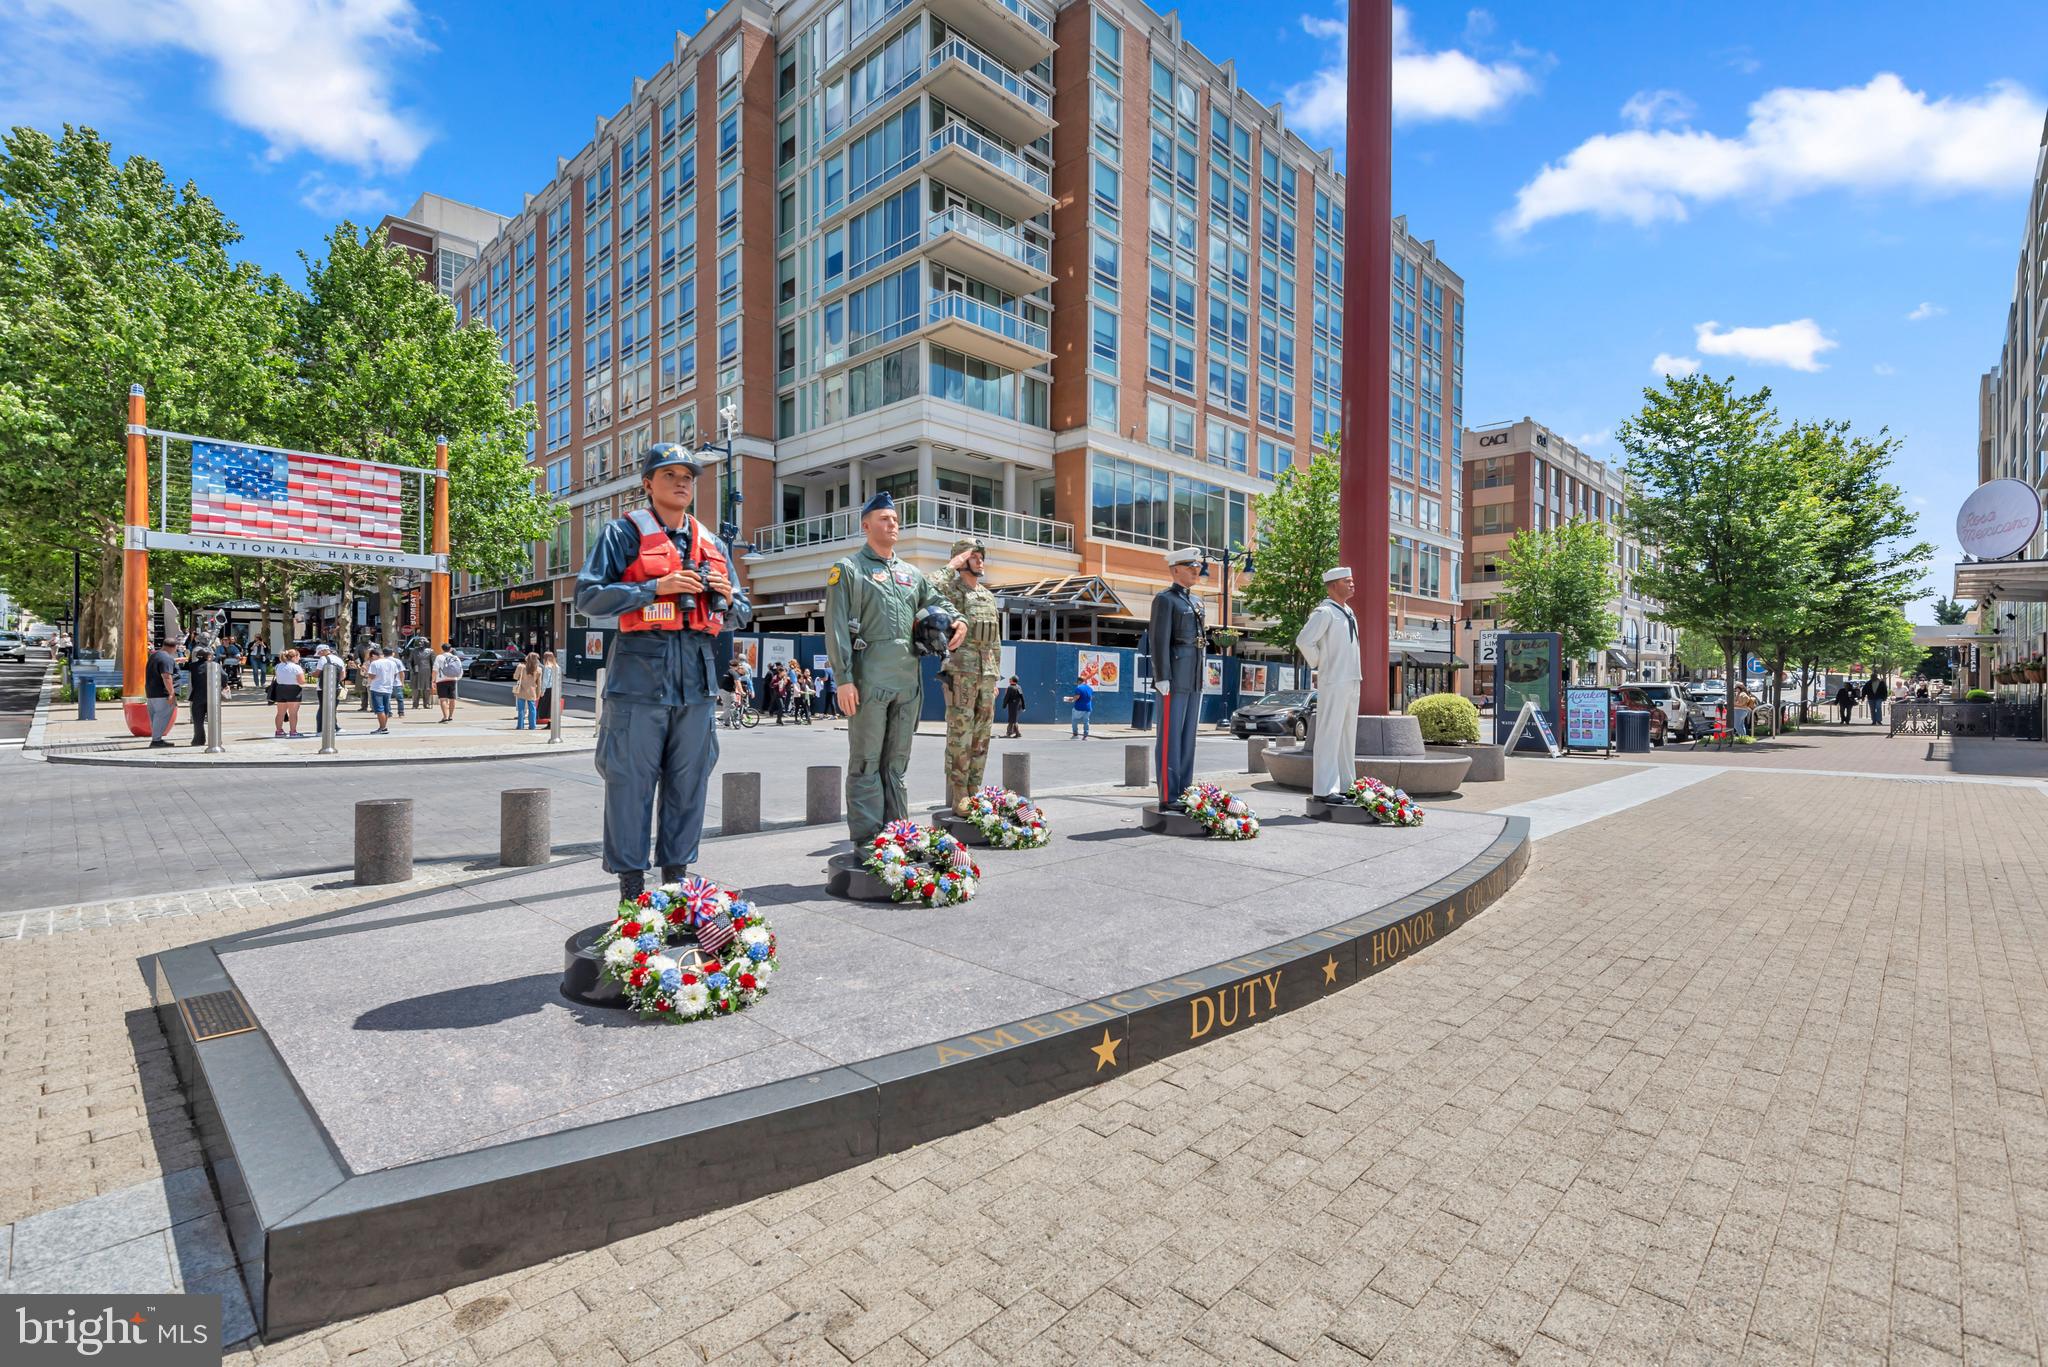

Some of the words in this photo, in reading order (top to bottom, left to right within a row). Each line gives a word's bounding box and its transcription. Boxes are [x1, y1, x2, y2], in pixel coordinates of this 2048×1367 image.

[1480, 433, 1508, 447] CACI
[201, 540, 300, 556] NATIONAL
[328, 550, 395, 563] HARBOR
[409, 592, 417, 626] BOMBAY
[1483, 647, 1498, 661] 2
[1372, 911, 1435, 967] HONOR
[936, 977, 1206, 1064] AMERICA'S
[1189, 970, 1283, 1040] DUTY
